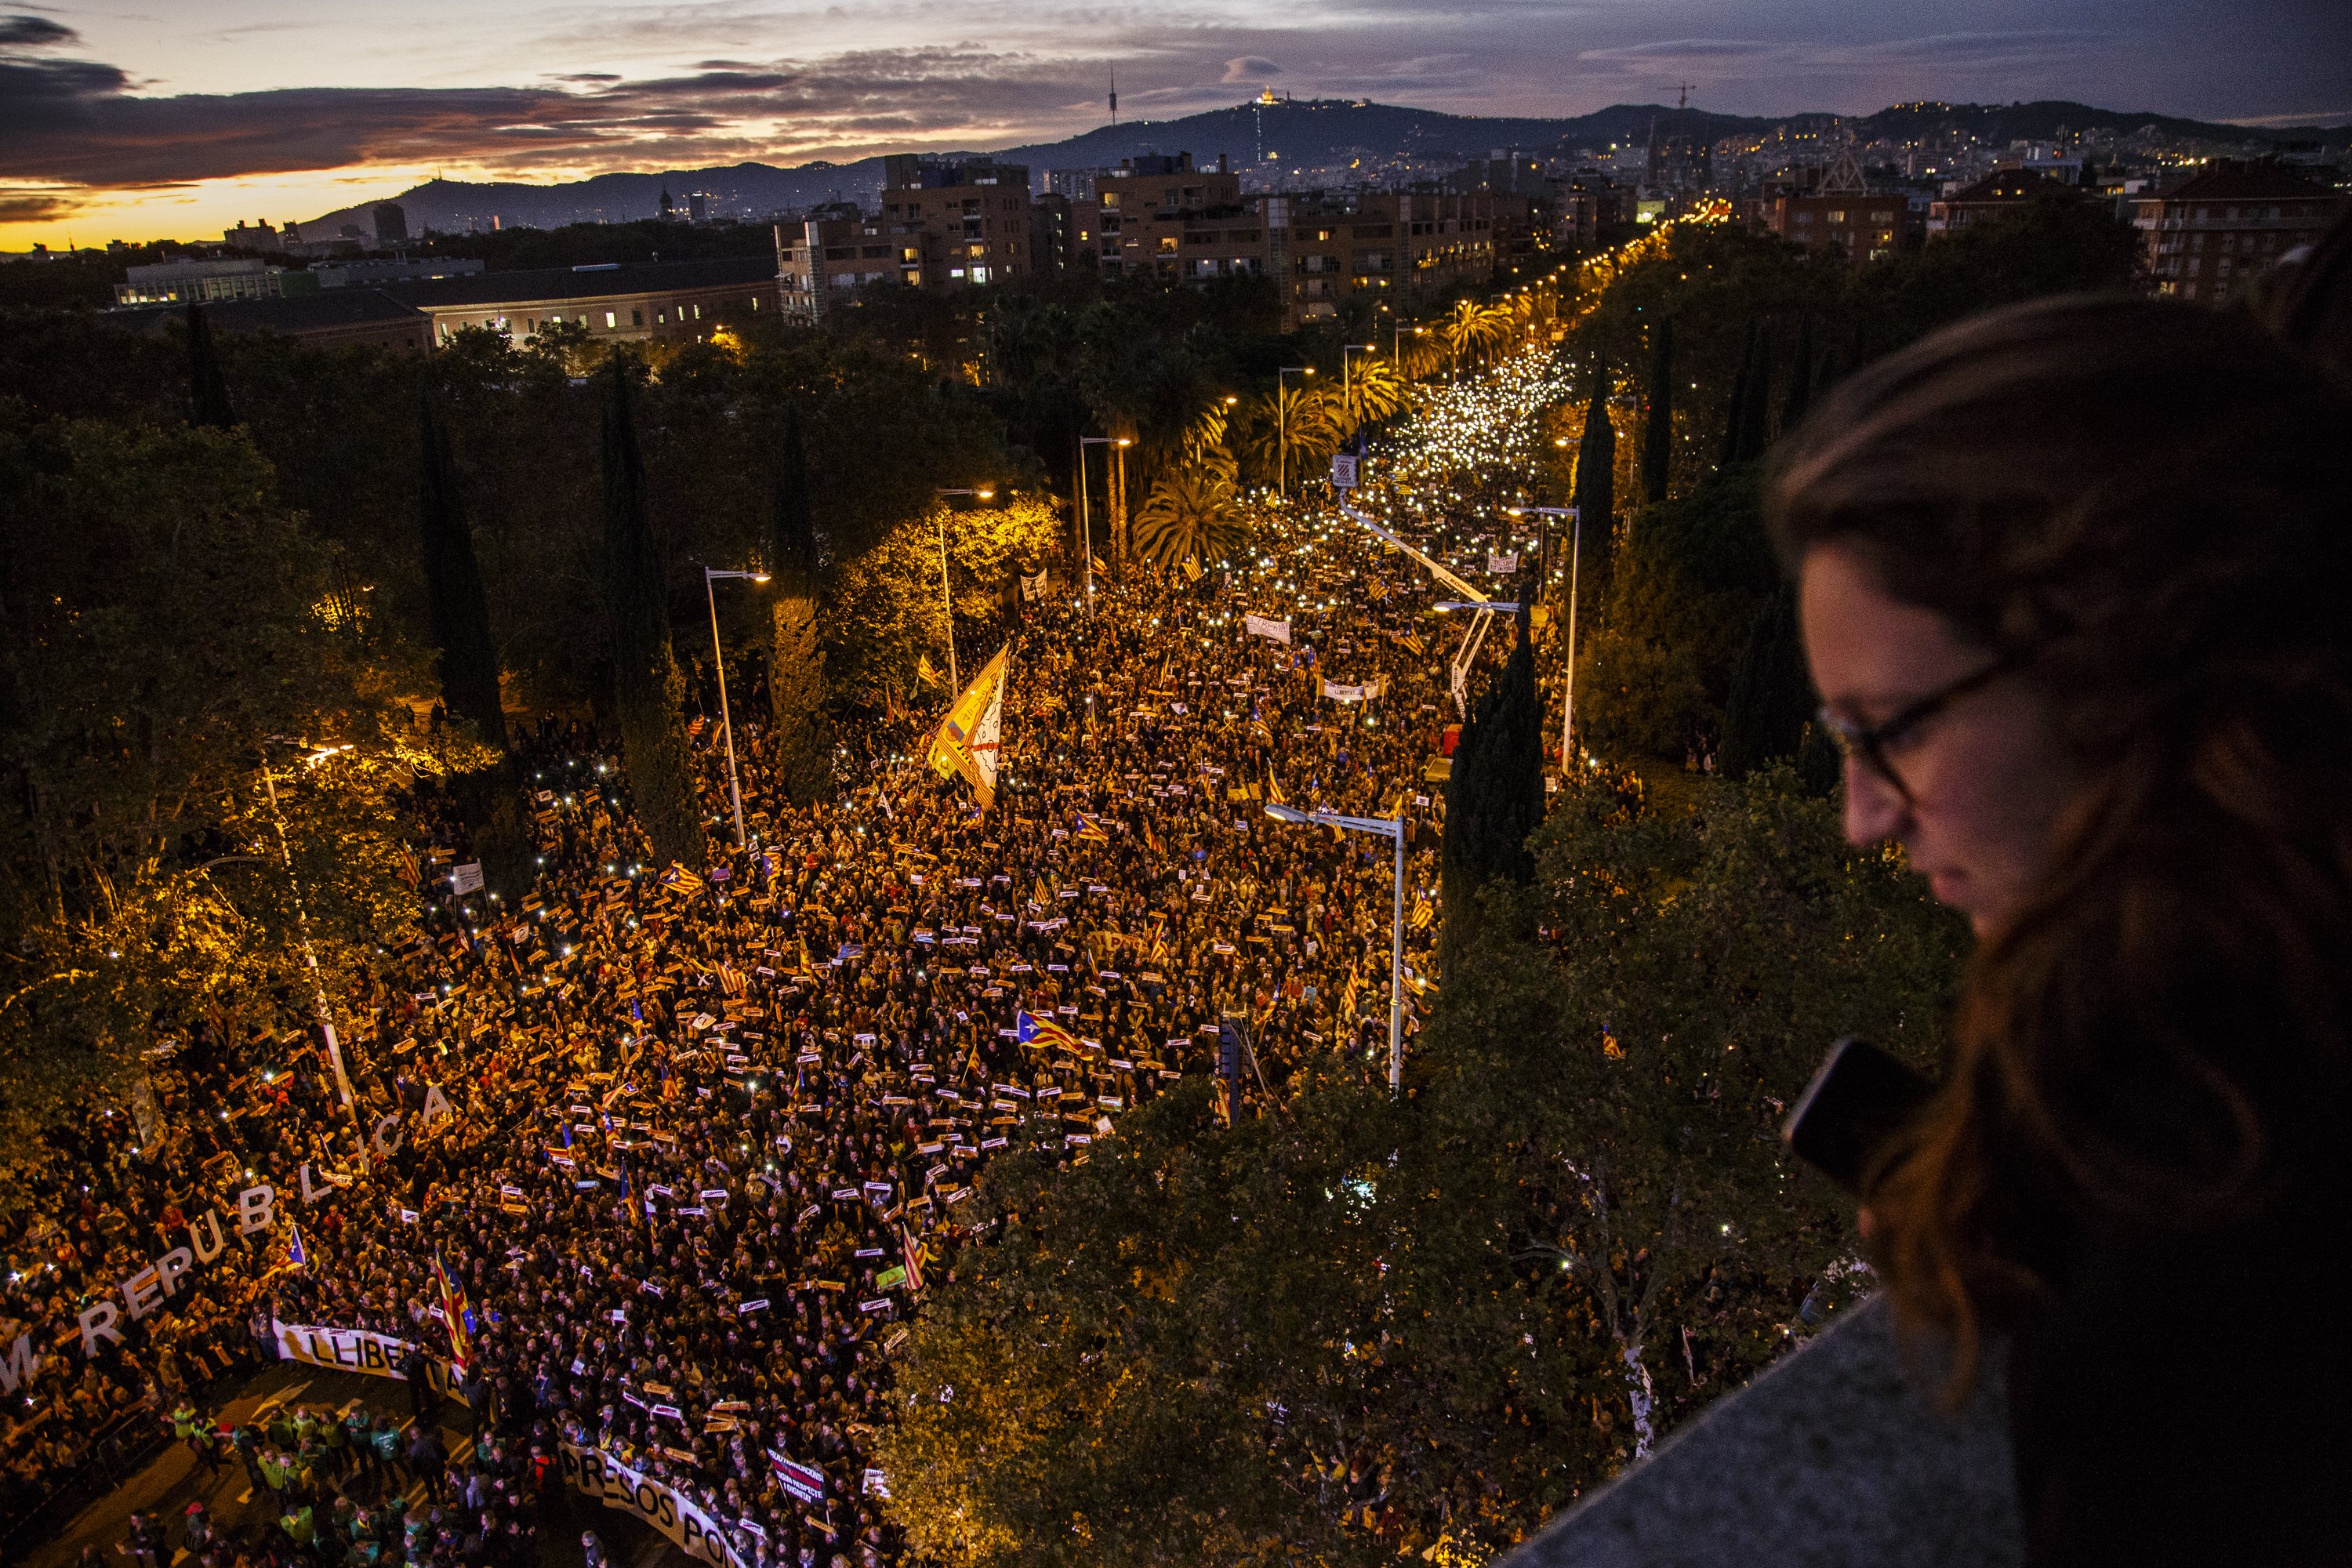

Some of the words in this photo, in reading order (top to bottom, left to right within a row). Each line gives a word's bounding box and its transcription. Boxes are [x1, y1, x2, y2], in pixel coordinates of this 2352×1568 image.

[744, 1300, 765, 1309] LLIBERTAT
[865, 1300, 886, 1310] LLIBERTAT
[562, 1449, 673, 1528] PRESOS
[786, 1484, 811, 1504] DIGNITAT
[793, 1479, 823, 1499] RESPECTE
